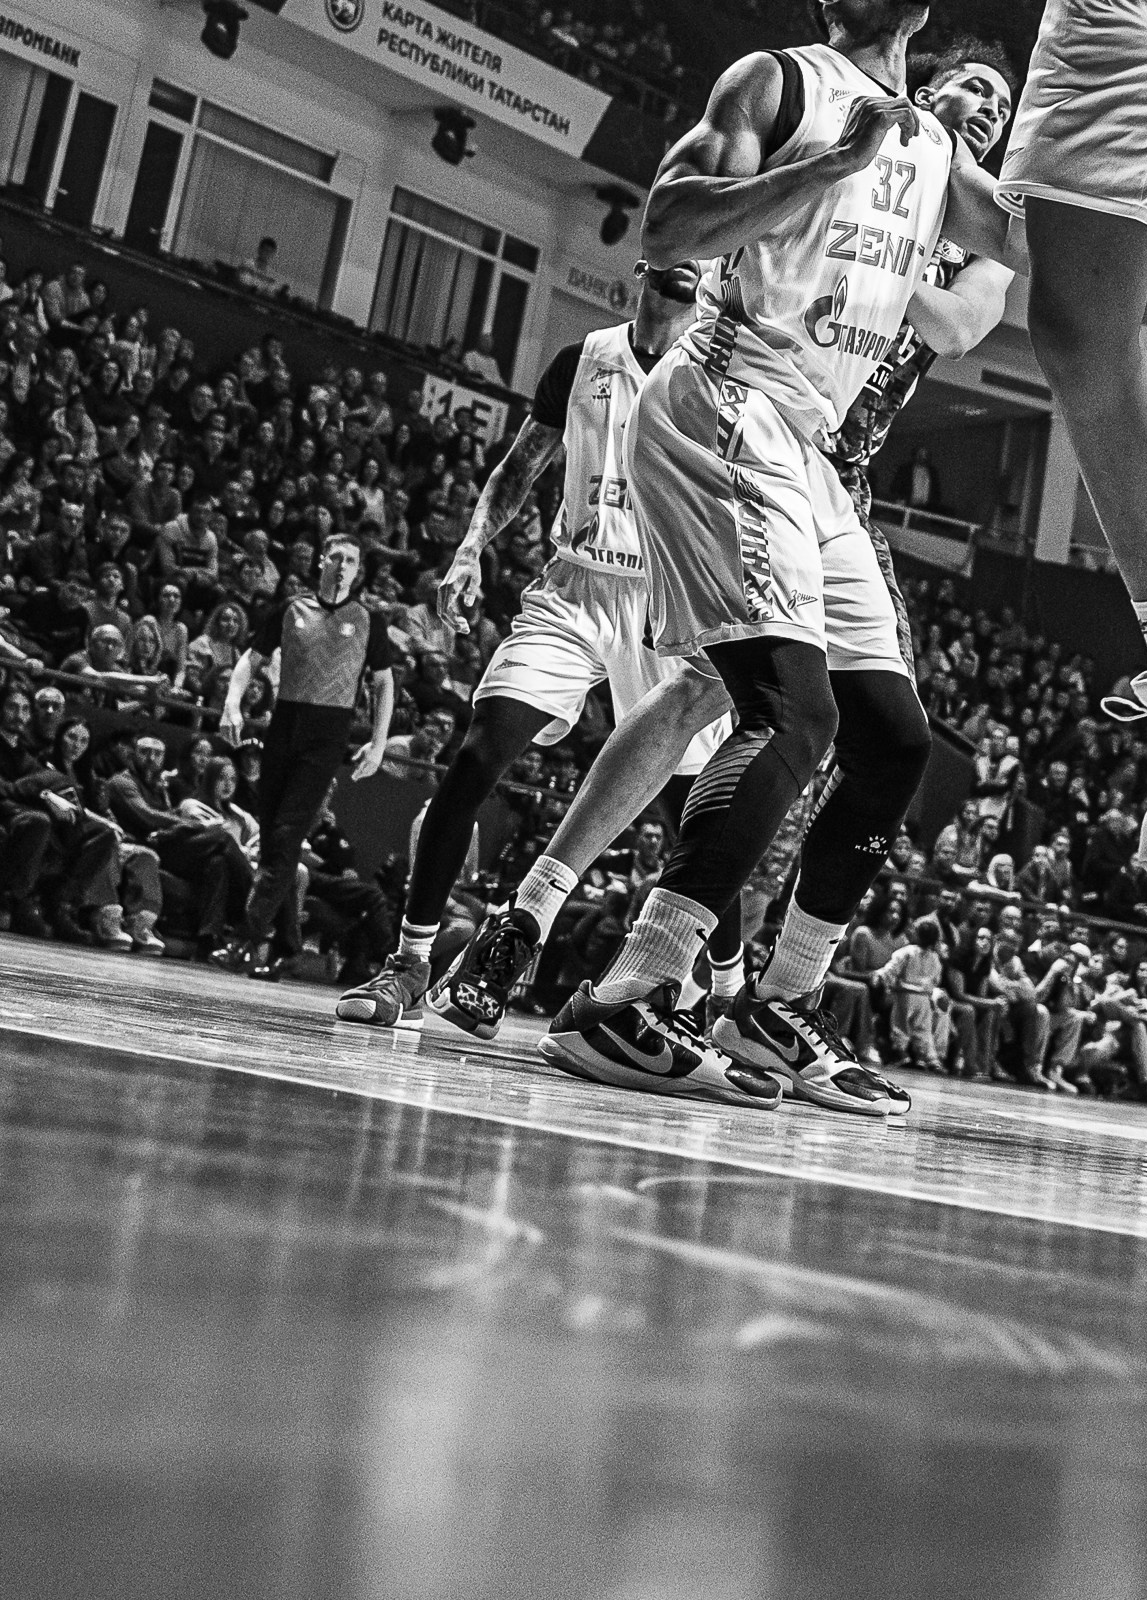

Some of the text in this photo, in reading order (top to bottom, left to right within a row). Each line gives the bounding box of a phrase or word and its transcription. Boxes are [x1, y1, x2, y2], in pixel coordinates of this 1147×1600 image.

[381, 0, 503, 74] КАРТА ЖИТЕЛЯ
[376, 26, 572, 136] РЕСПУБЛИКИ ТАТАРСТАН
[871, 153, 917, 219] 32
